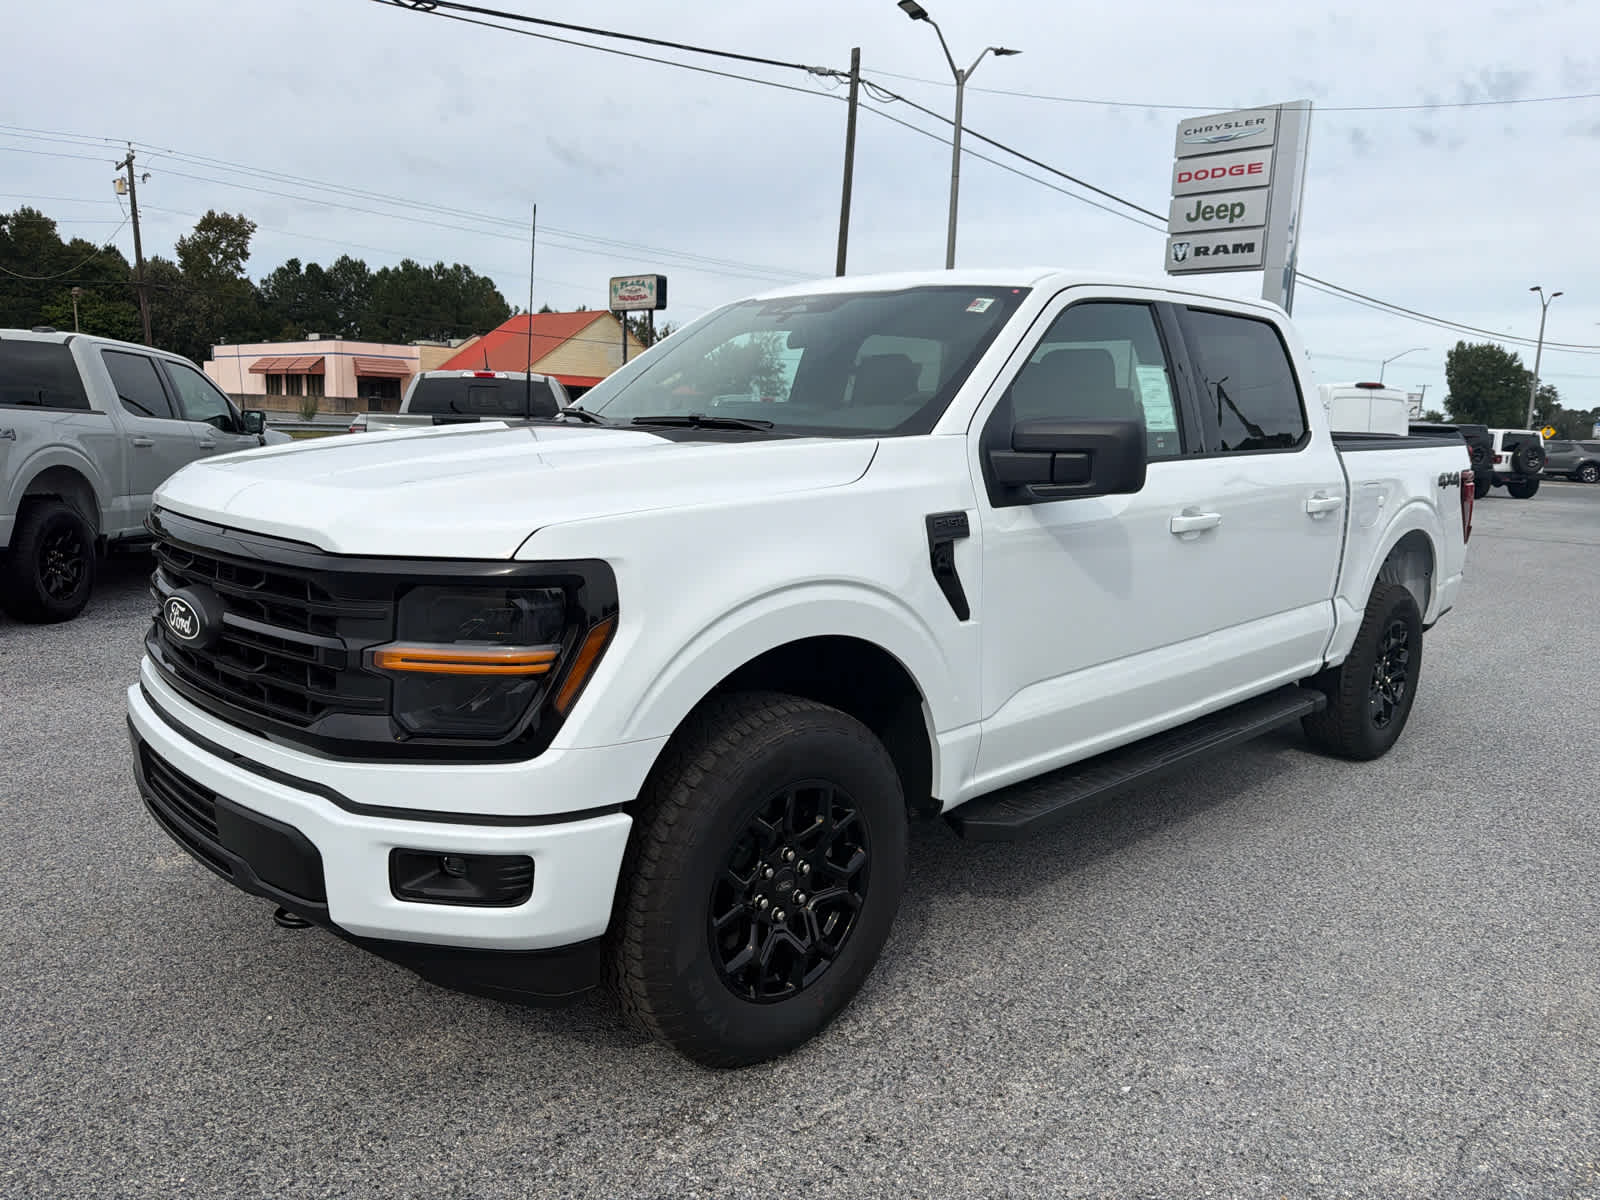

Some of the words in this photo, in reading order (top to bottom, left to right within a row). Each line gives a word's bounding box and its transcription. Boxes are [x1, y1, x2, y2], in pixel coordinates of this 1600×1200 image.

[1184, 118, 1266, 136] CHRYSLER
[1177, 162, 1264, 183] DODGE
[1186, 200, 1245, 223] Jeep
[1194, 242, 1255, 257] RAM
[169, 601, 192, 634] Ford
